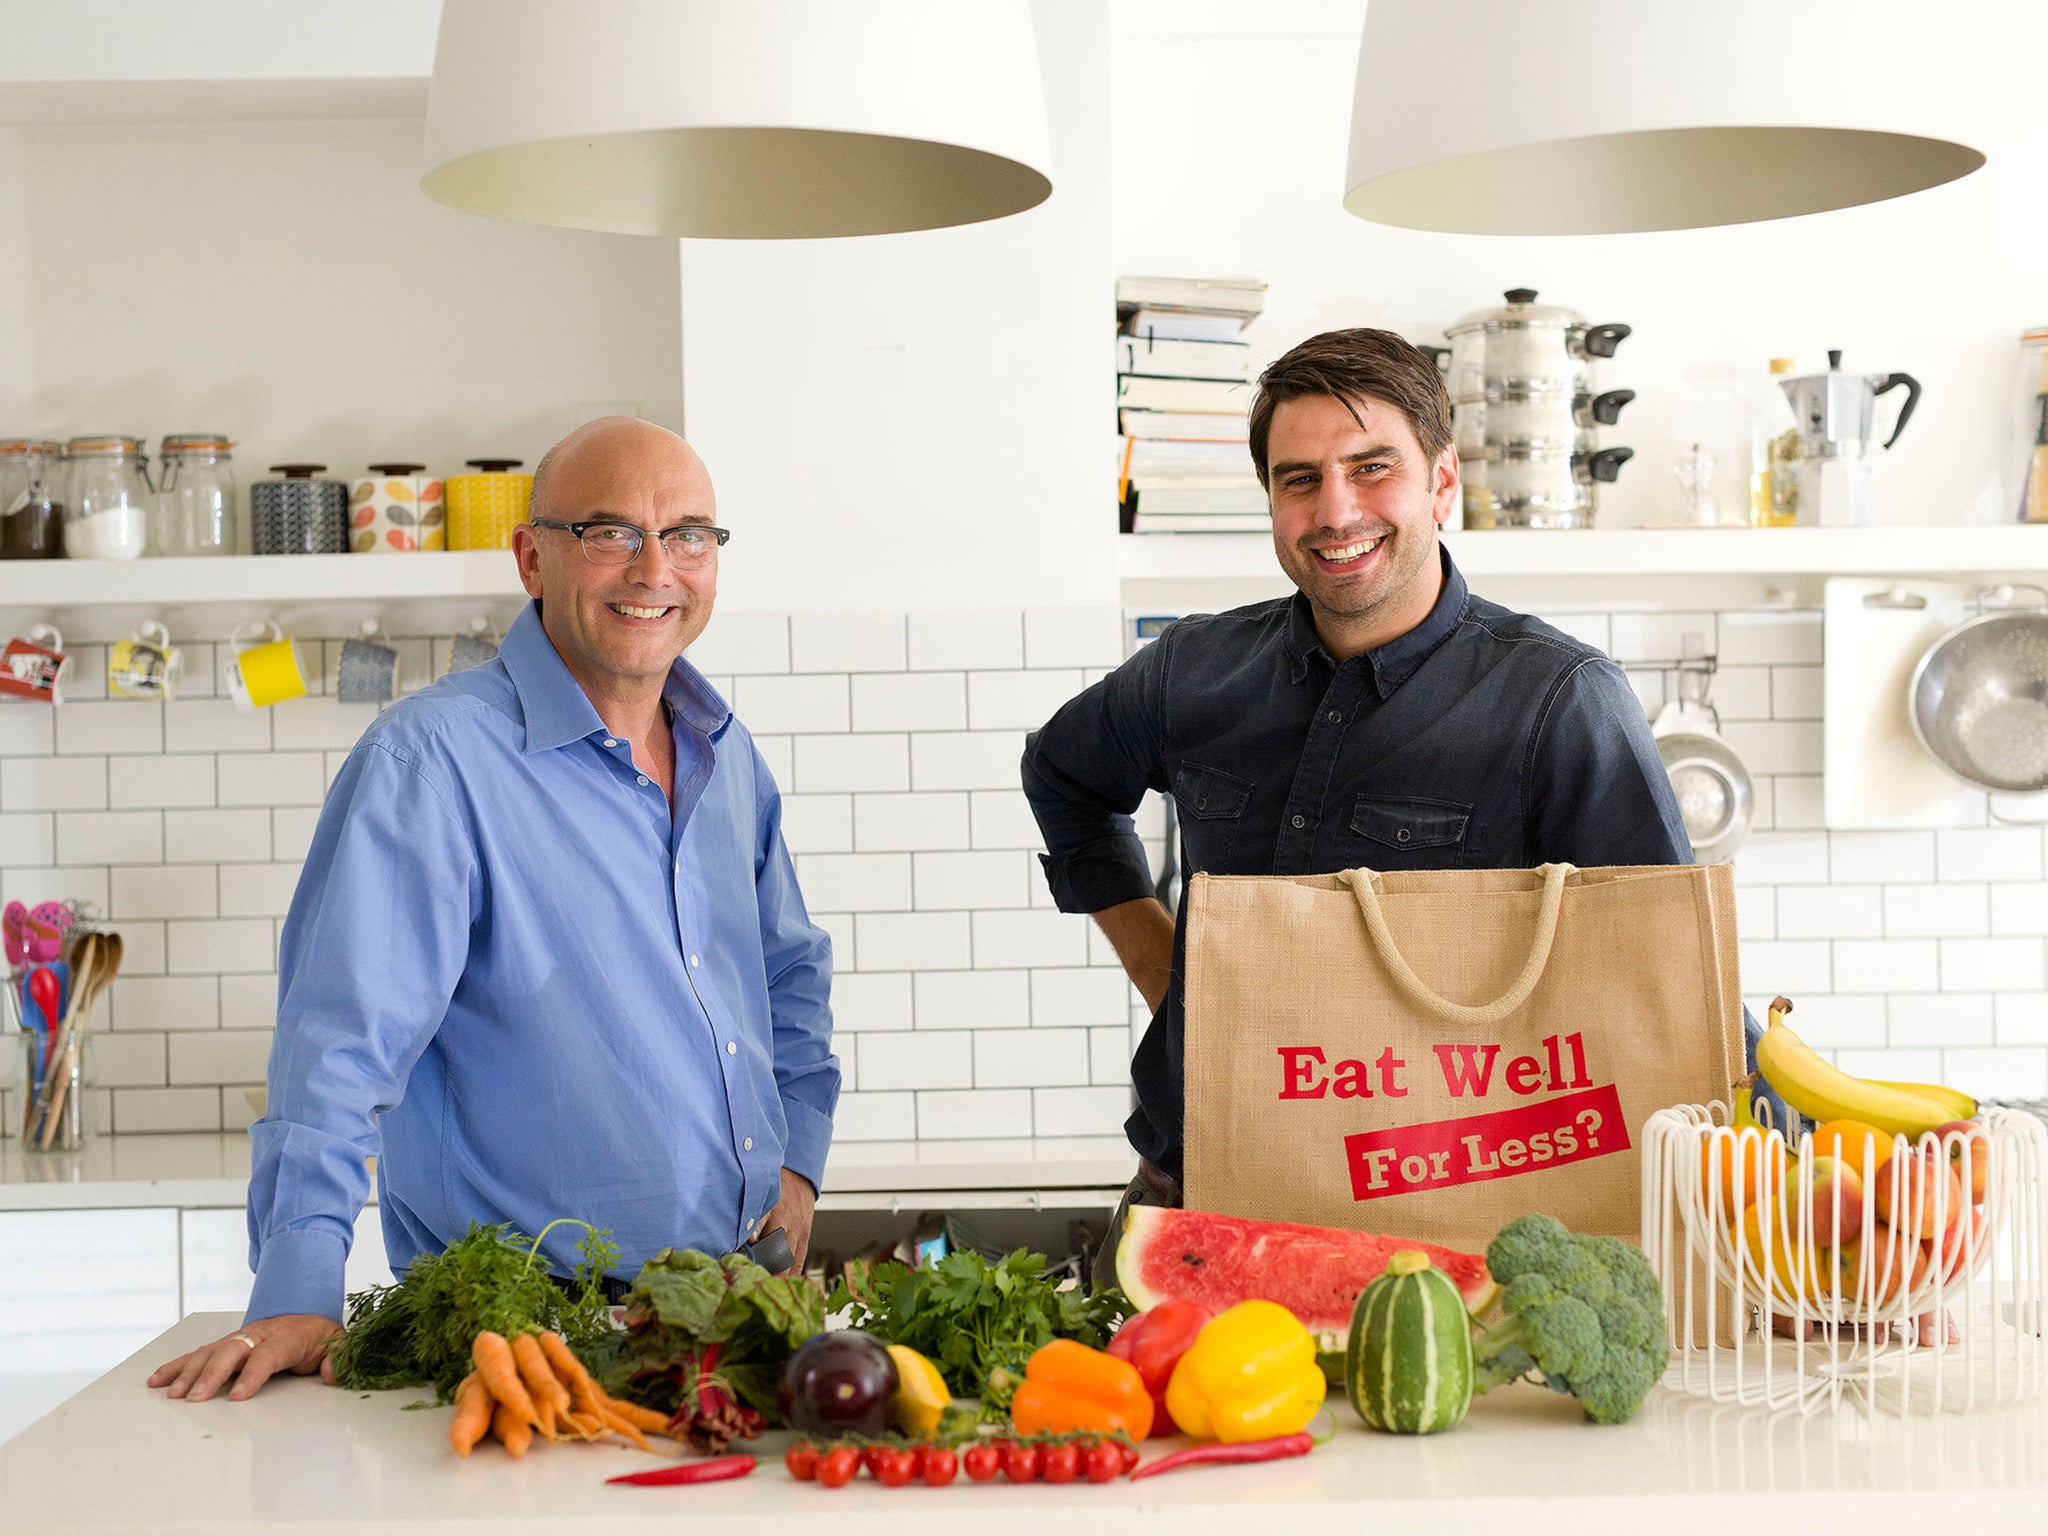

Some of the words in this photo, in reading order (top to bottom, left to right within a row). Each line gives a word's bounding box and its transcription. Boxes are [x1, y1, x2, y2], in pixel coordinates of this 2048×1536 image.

[1277, 1046, 1408, 1100] Eat
[1432, 1031, 1593, 1098] Well
[1362, 1148, 1451, 1190] For
[1461, 1108, 1603, 1174] Less?
